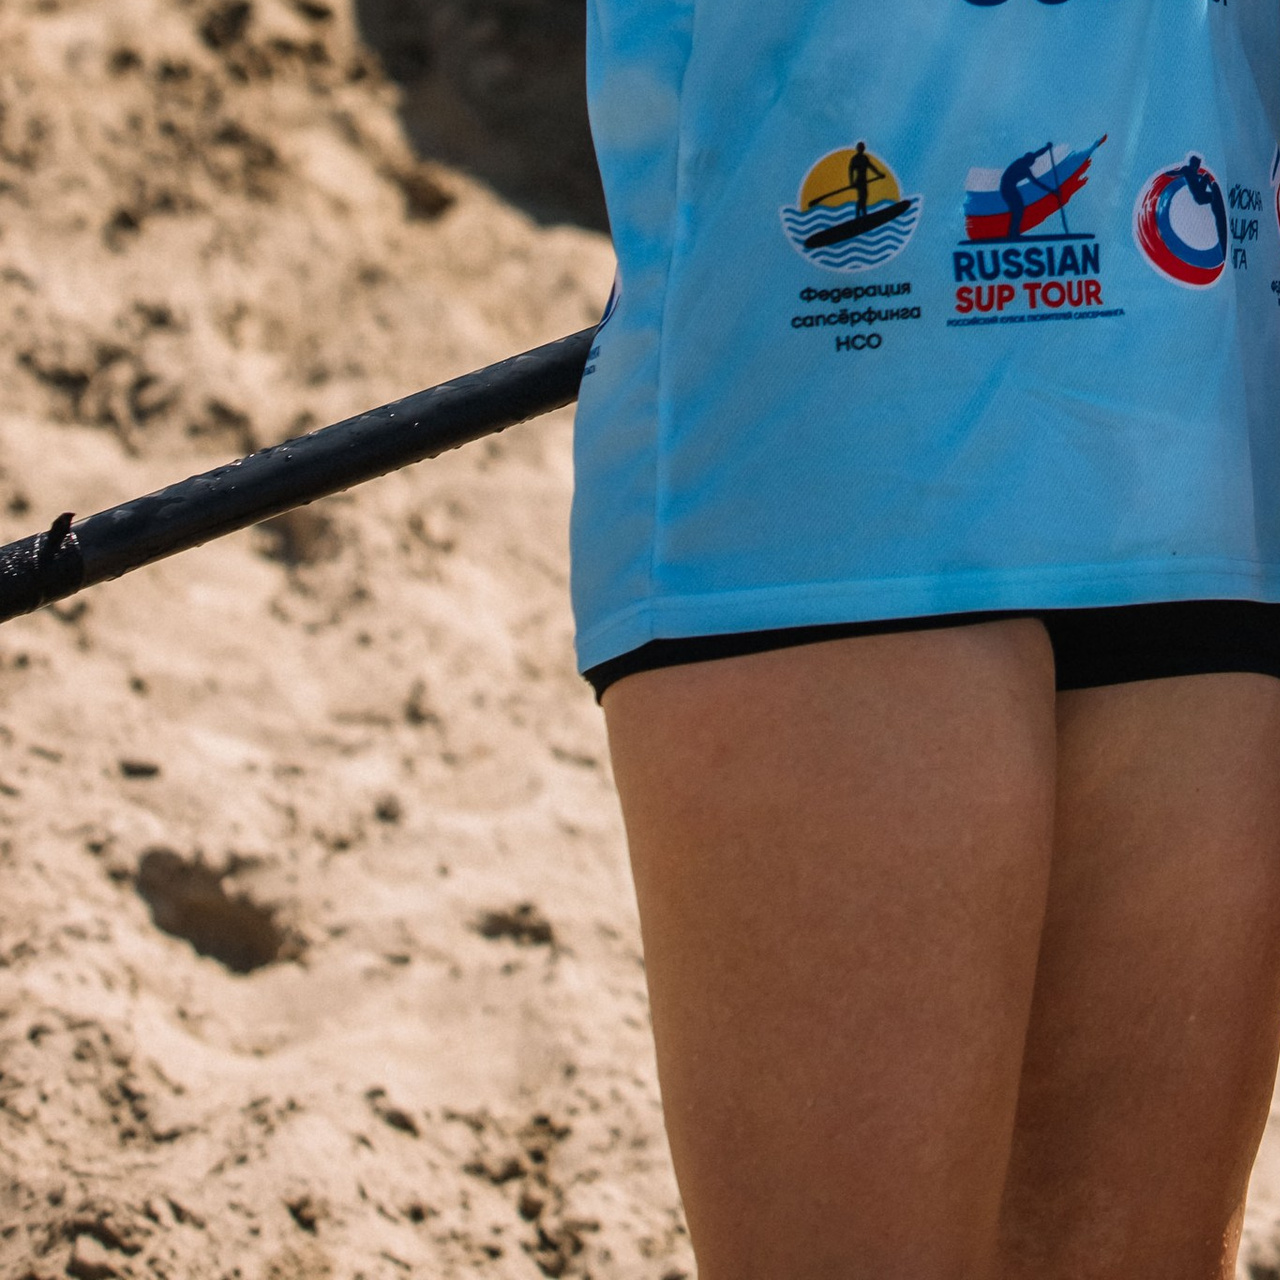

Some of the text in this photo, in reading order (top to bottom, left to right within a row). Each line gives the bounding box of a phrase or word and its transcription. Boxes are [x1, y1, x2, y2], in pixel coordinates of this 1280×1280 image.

[953, 243, 1100, 282] RUSSIAN
[799, 282, 911, 303] Федерация
[955, 279, 1103, 314] SUP TOUR
[791, 306, 921, 329] сапсёрфинга
[836, 333, 883, 352] НСО
